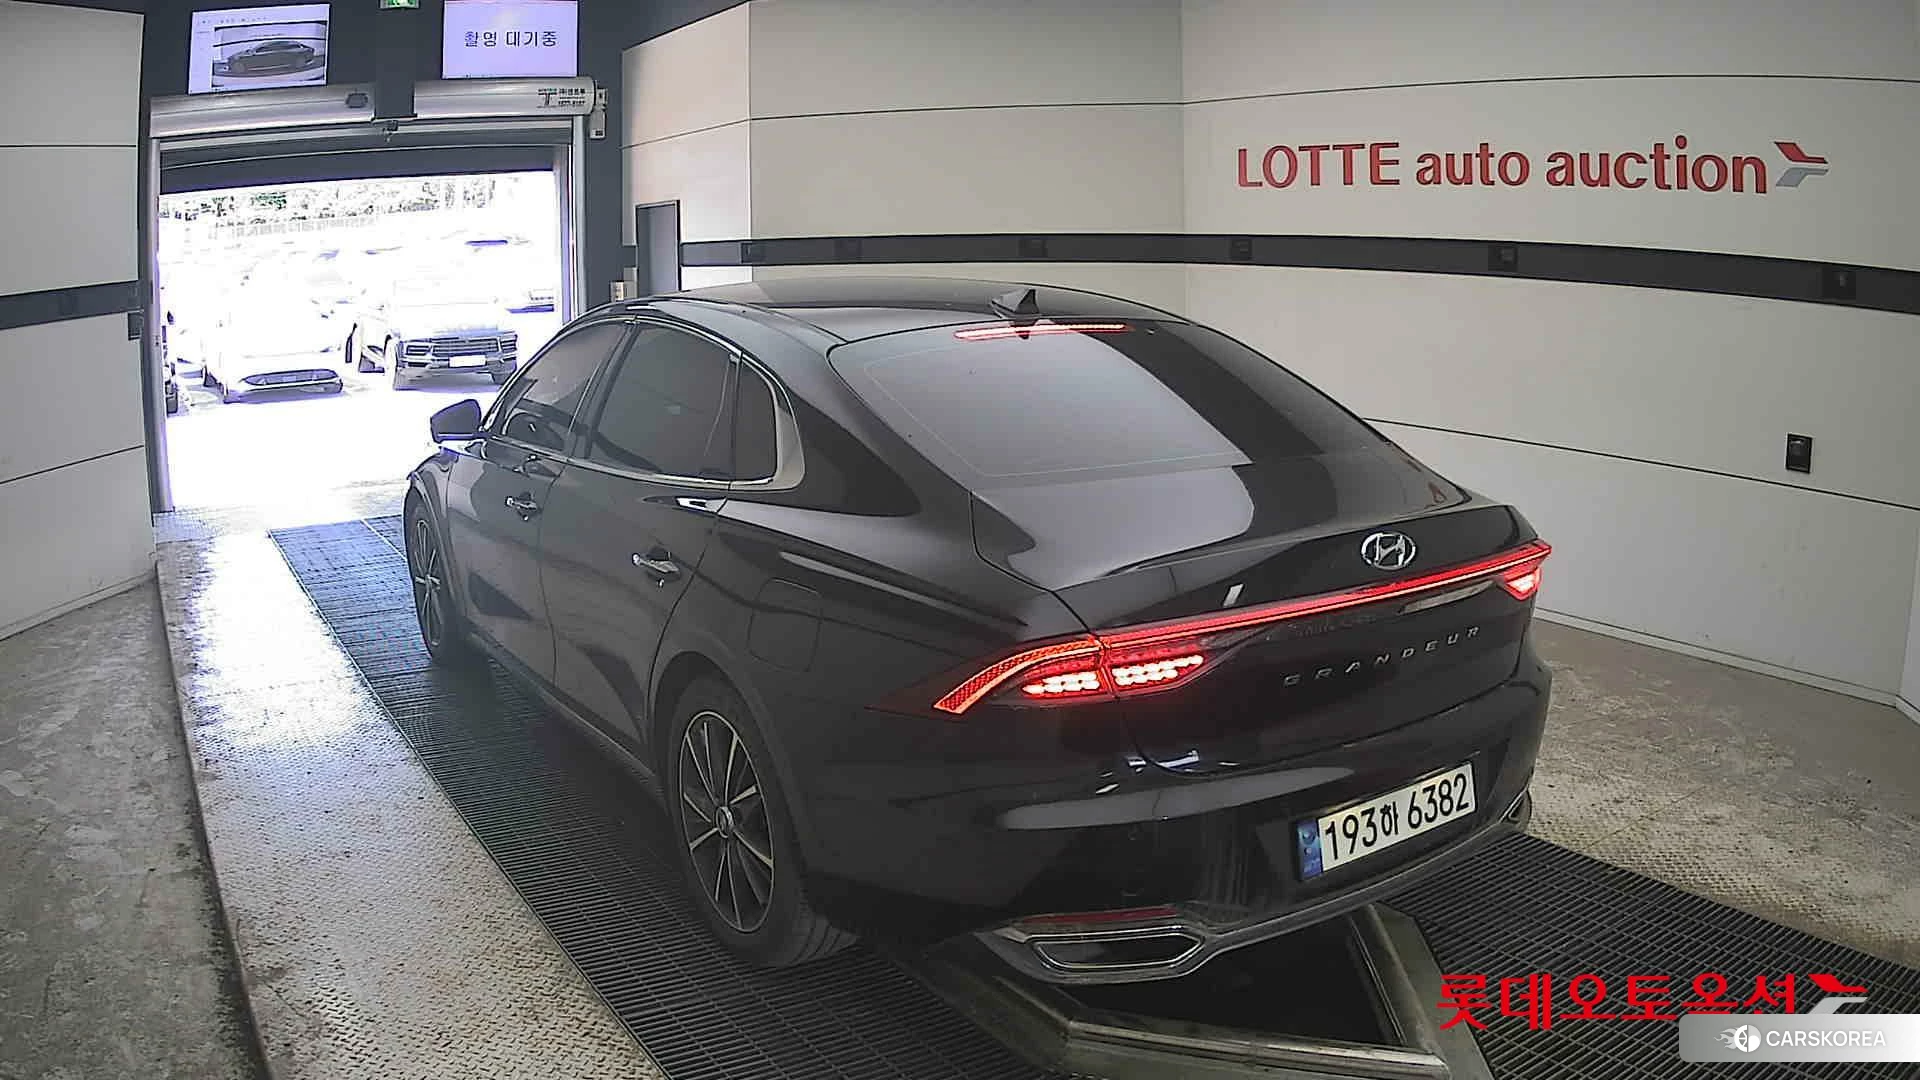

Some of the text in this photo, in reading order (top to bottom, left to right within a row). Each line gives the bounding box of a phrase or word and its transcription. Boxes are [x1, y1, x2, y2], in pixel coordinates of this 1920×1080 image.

[506, 31, 557, 47] 대기중
[1238, 134, 1767, 194] LOTTE auto auction
[1283, 626, 1480, 688] GRANDEUR
[1325, 773, 1470, 860] 193하 6382
